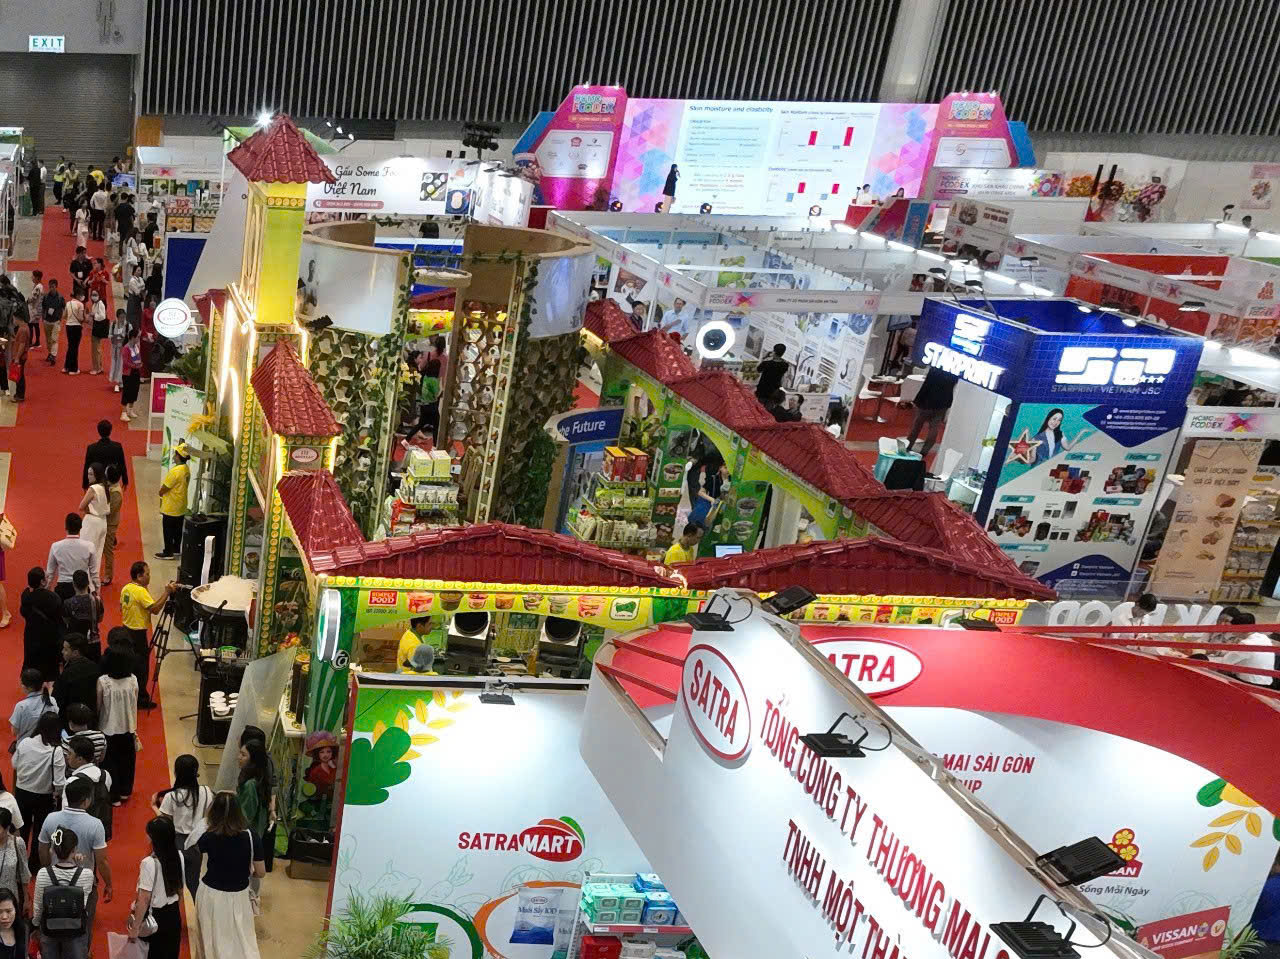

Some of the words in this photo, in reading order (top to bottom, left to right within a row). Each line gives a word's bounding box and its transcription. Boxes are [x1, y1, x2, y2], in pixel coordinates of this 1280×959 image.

[32, 37, 63, 49] EXIT
[351, 183, 377, 195] Nam
[572, 418, 605, 435] Future
[827, 653, 897, 682] ATRA
[689, 658, 740, 746] SATRA
[973, 753, 1002, 773] SÀI
[1003, 752, 1035, 774] GÒN
[458, 832, 578, 855] SATRAMART
[839, 784, 867, 844] TY
[866, 813, 946, 928] THƯƠNG
[783, 818, 827, 896] TNHH
[822, 870, 867, 943] MỘT
[1124, 886, 1150, 897] Ngày
[1152, 924, 1198, 945] VISSAN
